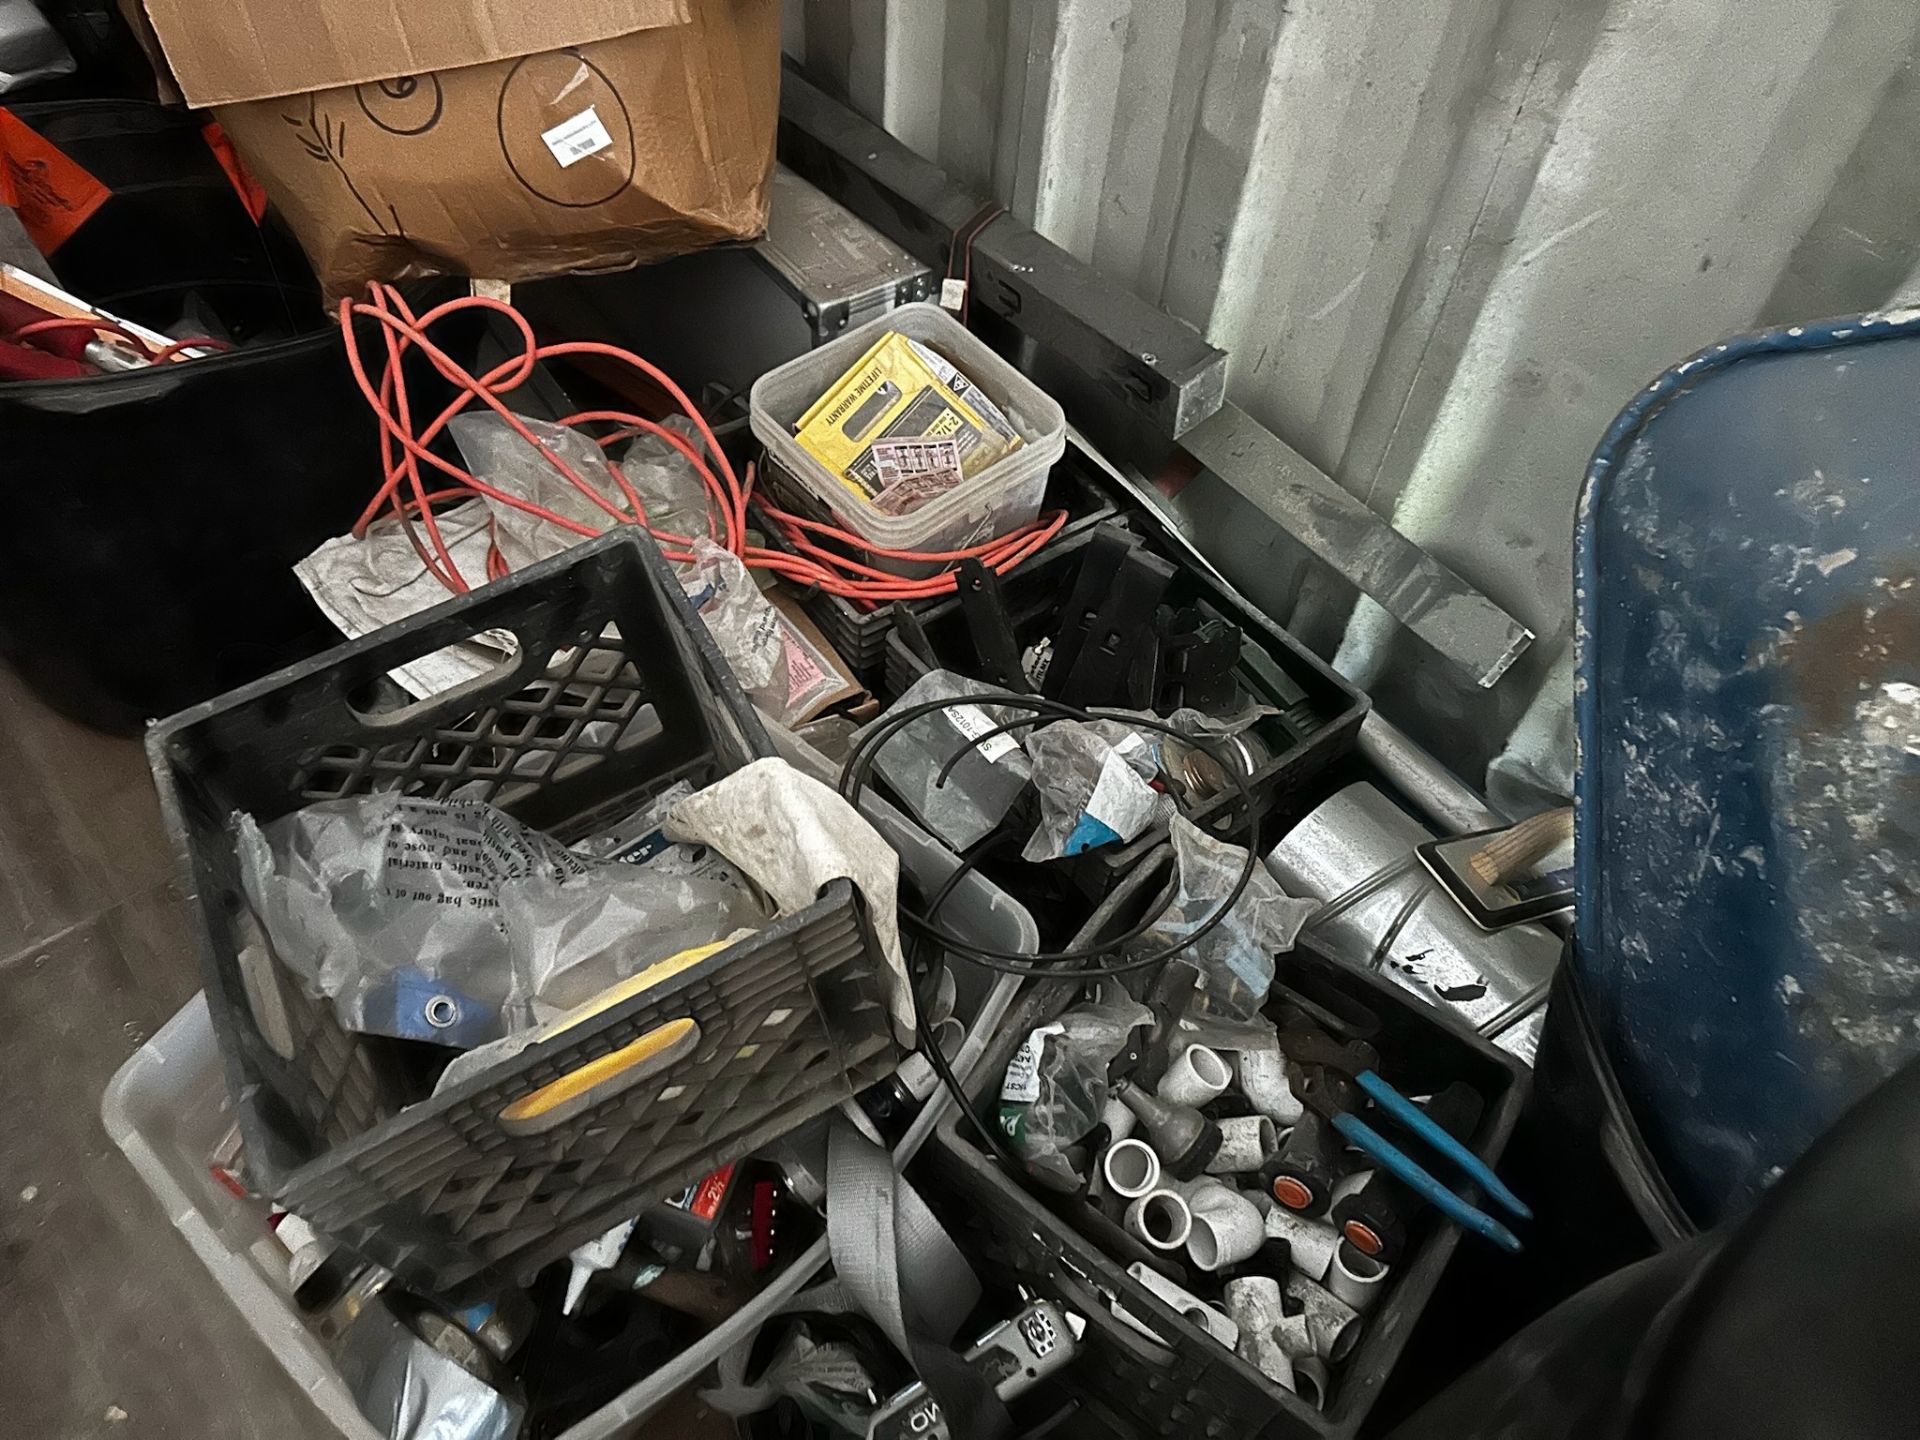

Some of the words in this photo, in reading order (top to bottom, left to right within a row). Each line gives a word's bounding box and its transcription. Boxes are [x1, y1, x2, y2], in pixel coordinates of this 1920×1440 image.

[855, 367, 883, 397] LIFETIME
[826, 393, 858, 426] WARRANTY
[388, 857, 442, 870] material
[413, 892, 431, 901] out
[437, 892, 462, 907] bag
